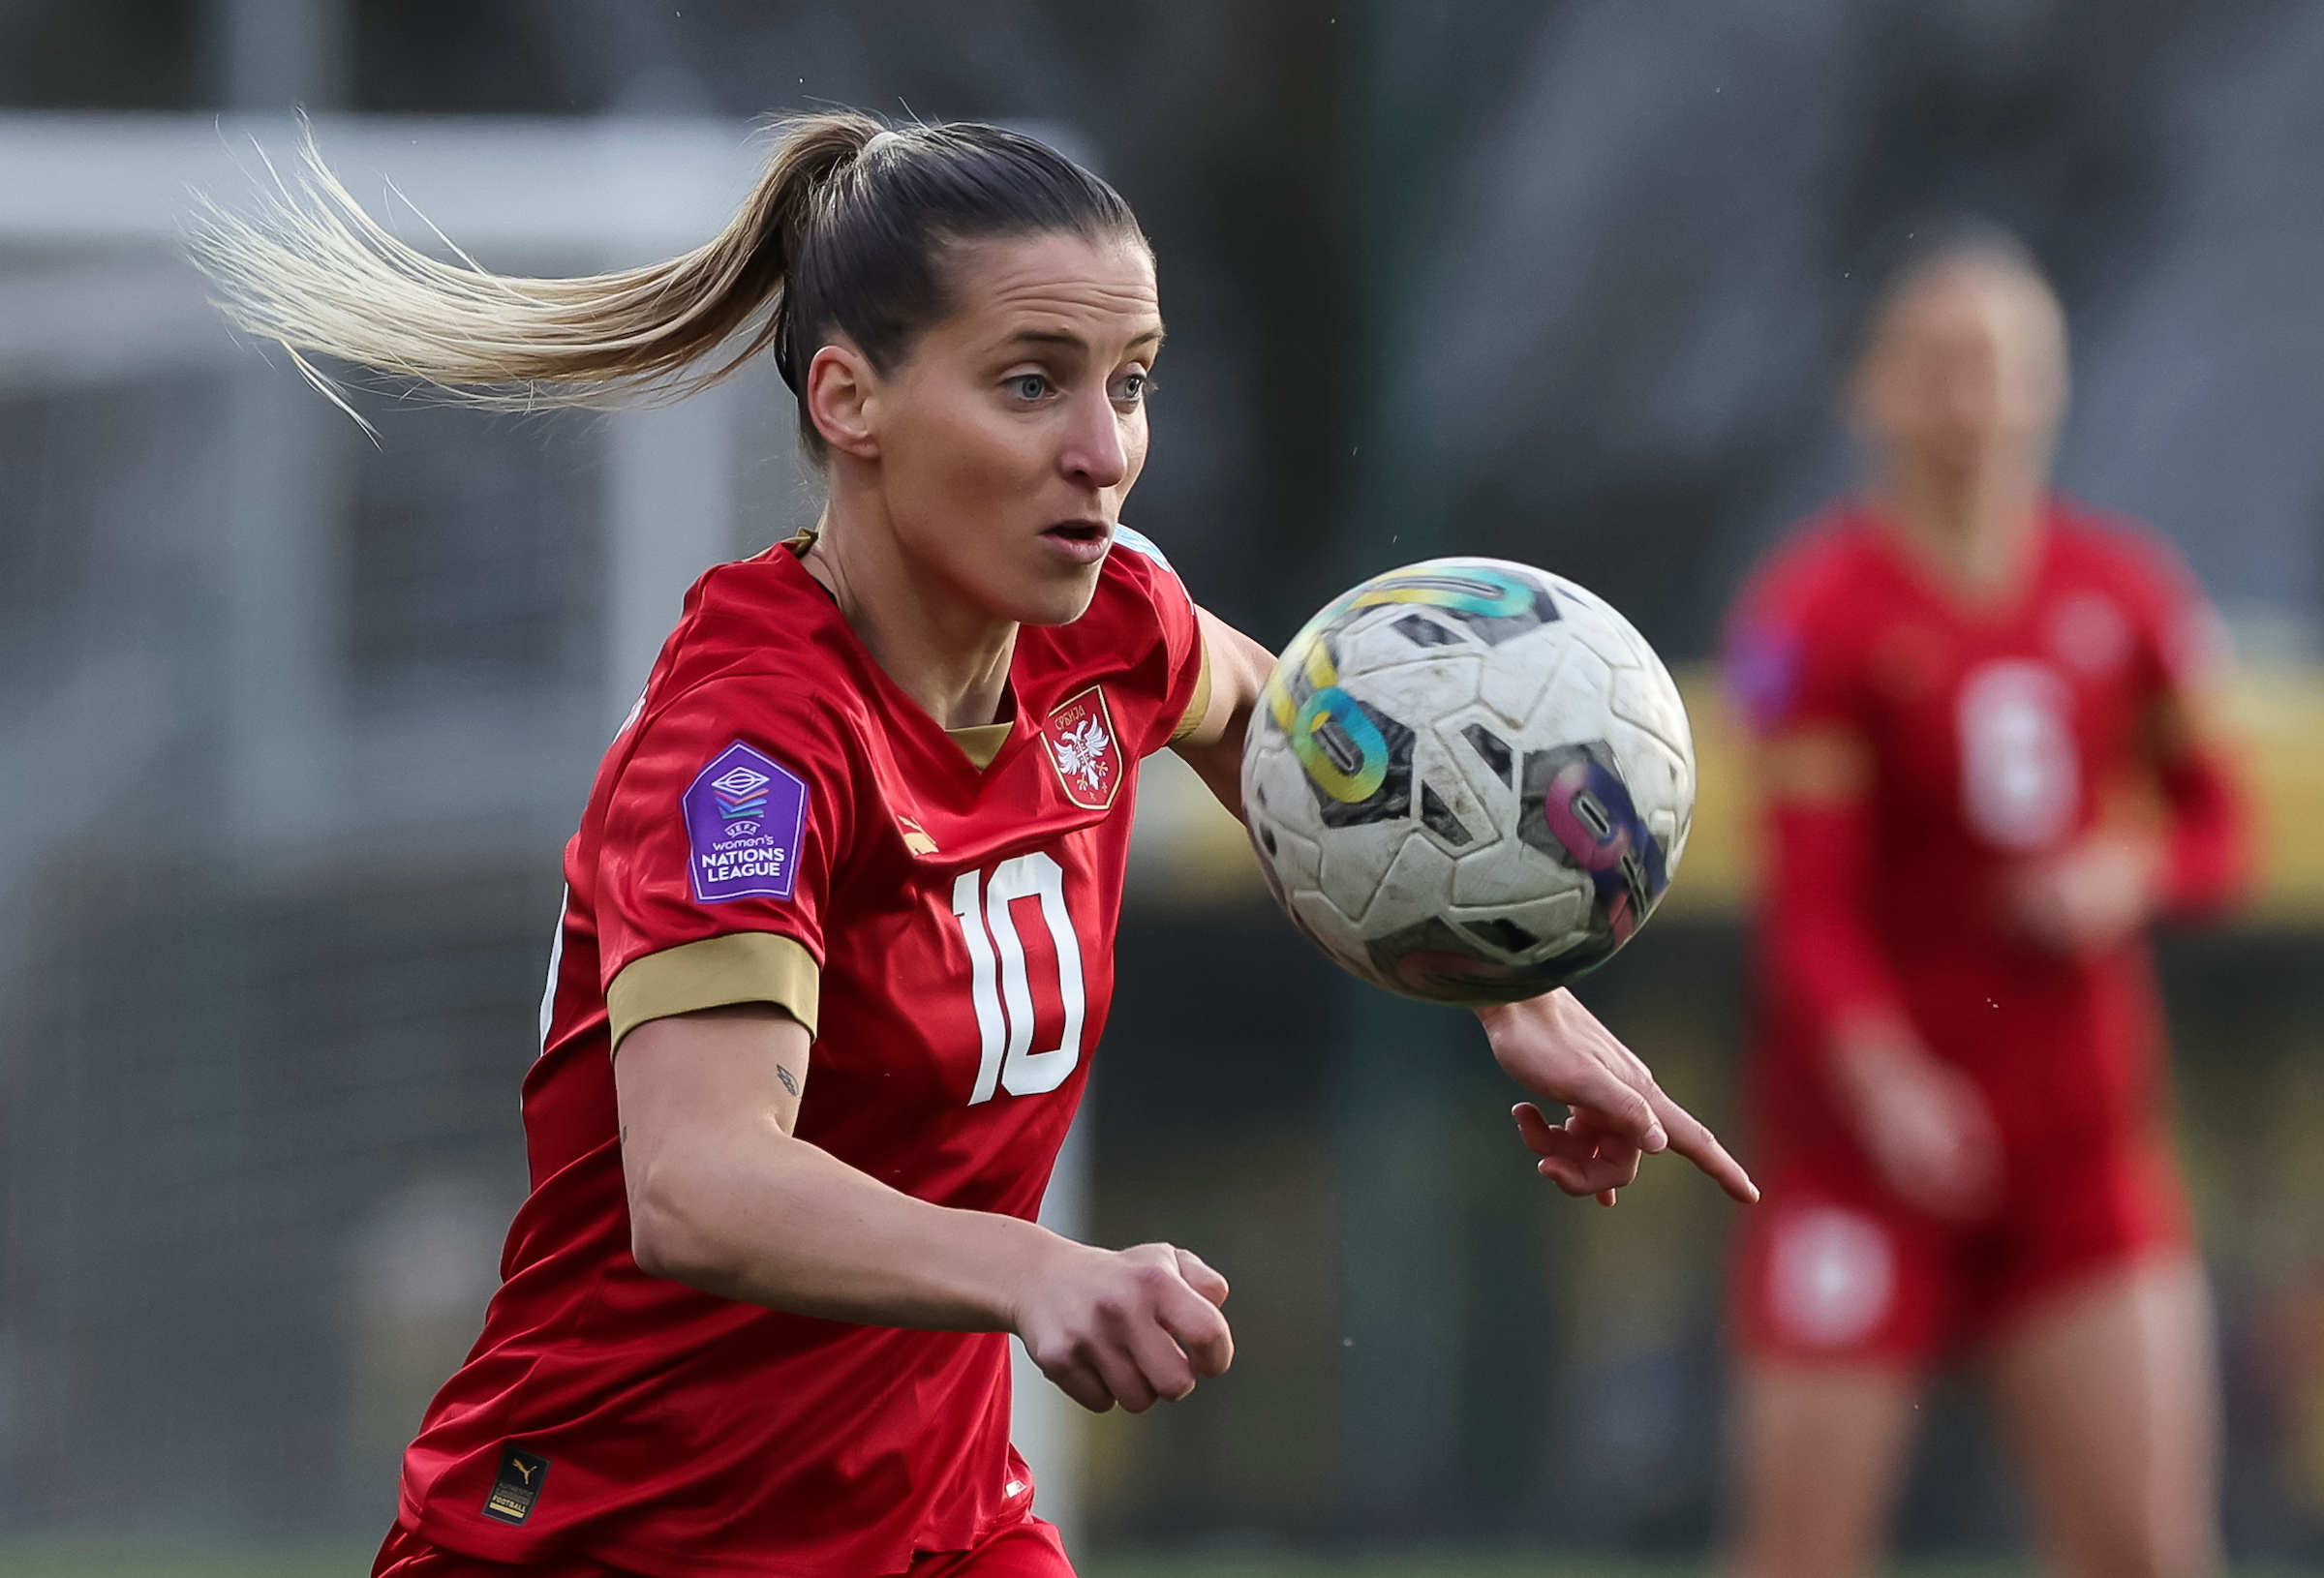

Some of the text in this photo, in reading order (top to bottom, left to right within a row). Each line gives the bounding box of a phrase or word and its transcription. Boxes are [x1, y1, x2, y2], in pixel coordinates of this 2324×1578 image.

[1055, 704, 1086, 731] СРБИЈА
[726, 823, 757, 836] UEFA
[712, 834, 775, 851] women's
[701, 847, 785, 868] NATIONS
[707, 862, 780, 883] LEAGUE
[952, 851, 1086, 1107] 10
[491, 1494, 526, 1513] FOOTBALL
